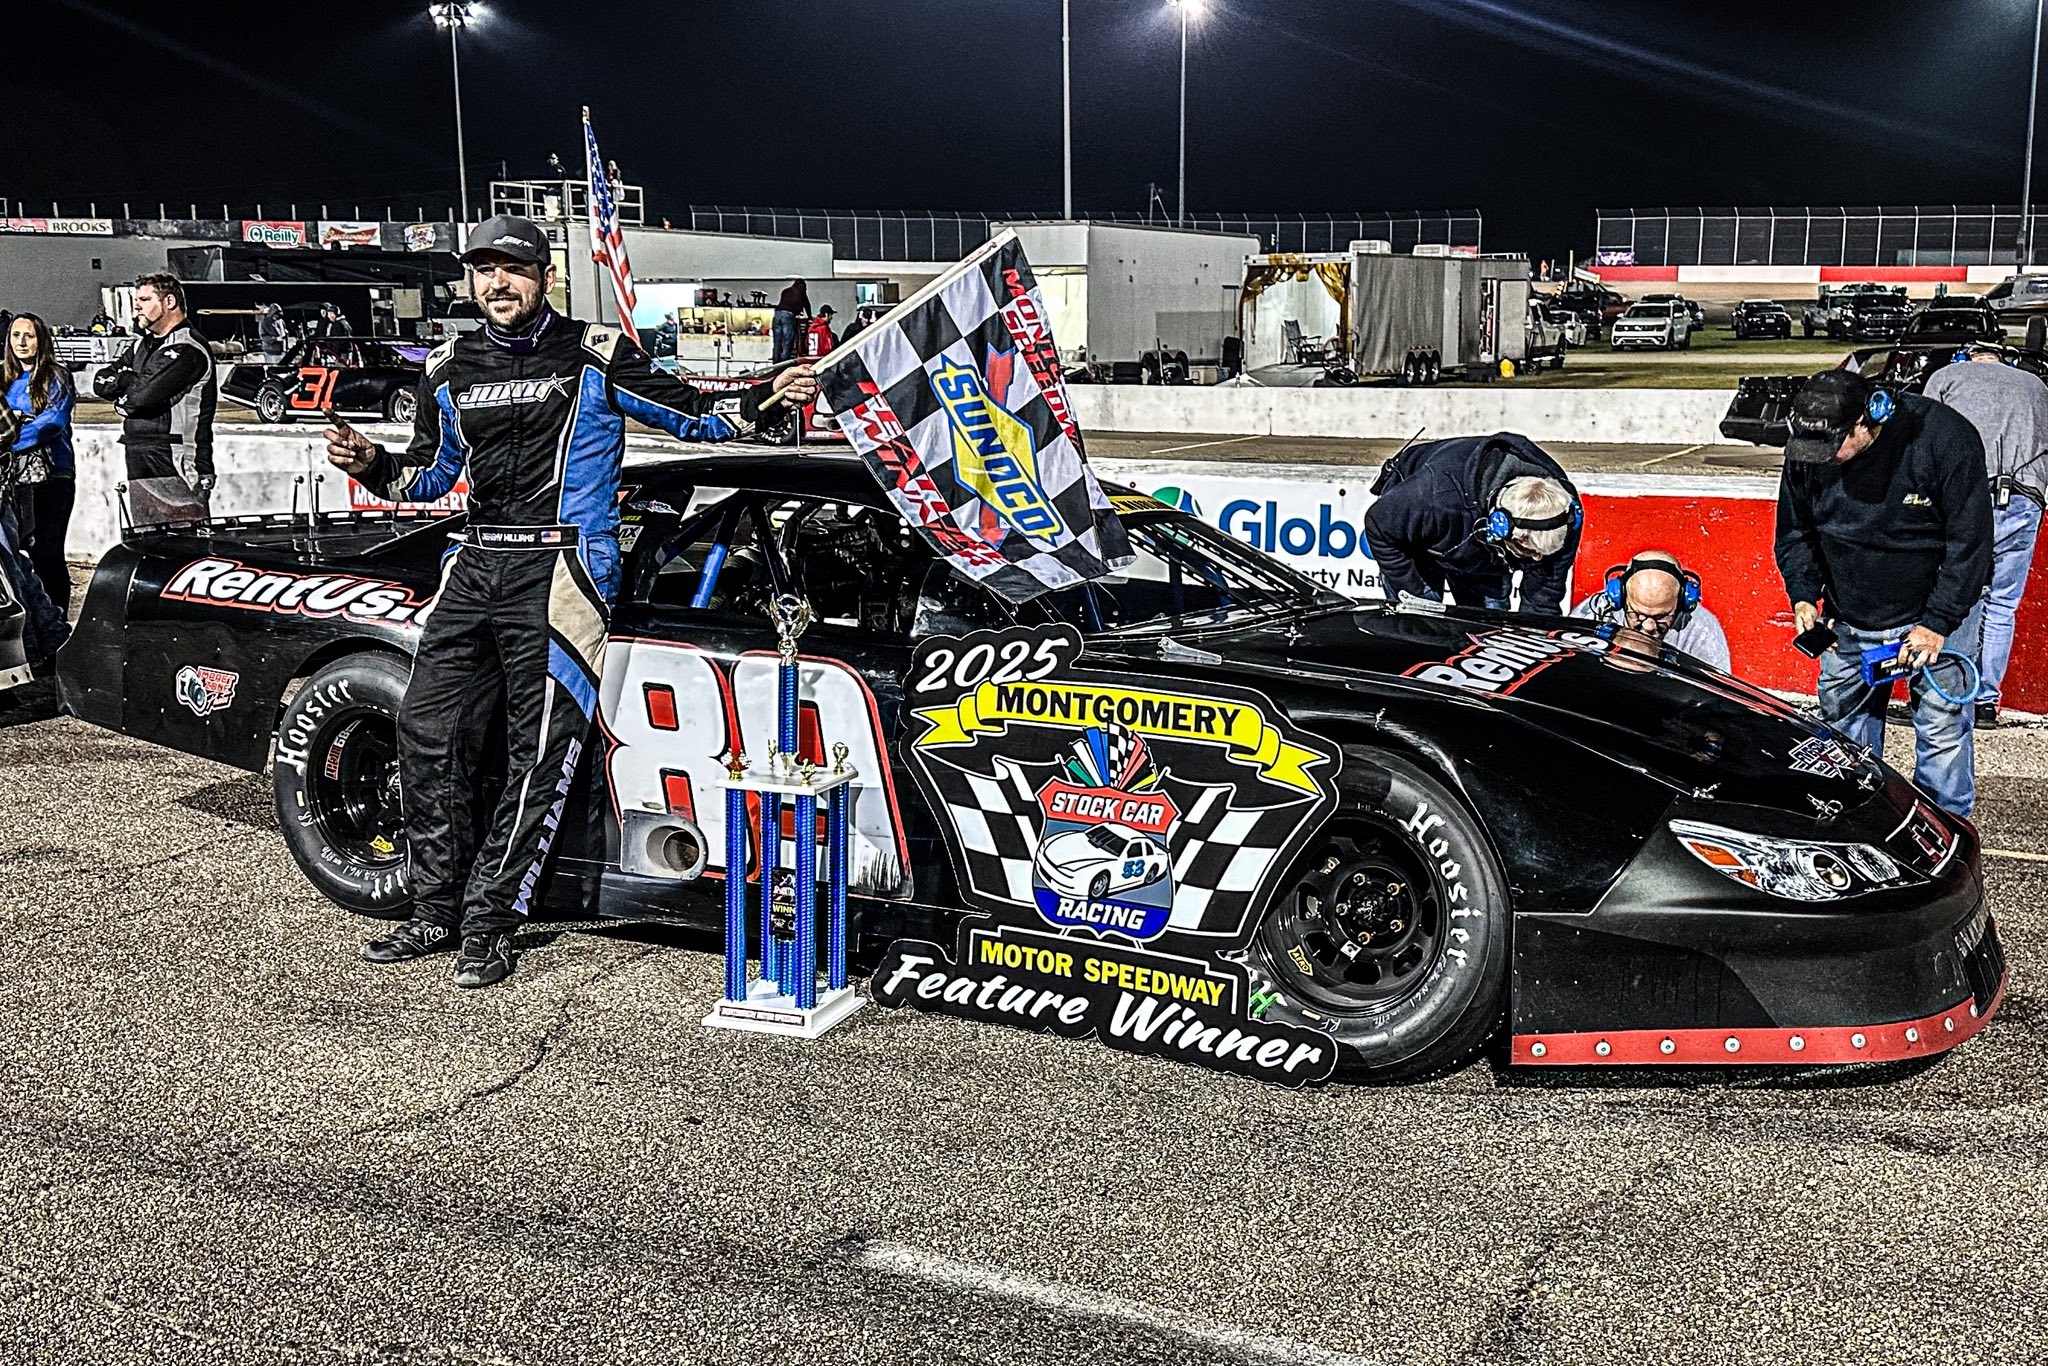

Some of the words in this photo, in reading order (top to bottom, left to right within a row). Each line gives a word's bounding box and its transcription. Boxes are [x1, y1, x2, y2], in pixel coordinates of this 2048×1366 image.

[53, 222, 106, 231] BROOKS
[249, 226, 299, 244] O'Reilly
[291, 367, 339, 409] 31
[939, 373, 1056, 533] SUNOCO
[914, 636, 1072, 693] 2025
[275, 678, 355, 777] Hoosier
[996, 687, 1241, 738] MONTGOMERY
[511, 737, 583, 917] WILLIAMS
[1050, 792, 1120, 820] STOCK
[1121, 798, 1165, 826] CAR
[1121, 859, 1146, 879] 53
[1396, 802, 1483, 968] Hoosier
[773, 904, 796, 914] WINN
[1056, 898, 1147, 931] RACING
[980, 939, 1074, 979] MOTOR
[1083, 957, 1226, 1007] SPEEDWAY
[882, 953, 1088, 1025] Feature
[1108, 992, 1324, 1074] Winner
[1317, 1018, 1342, 1033] RF
